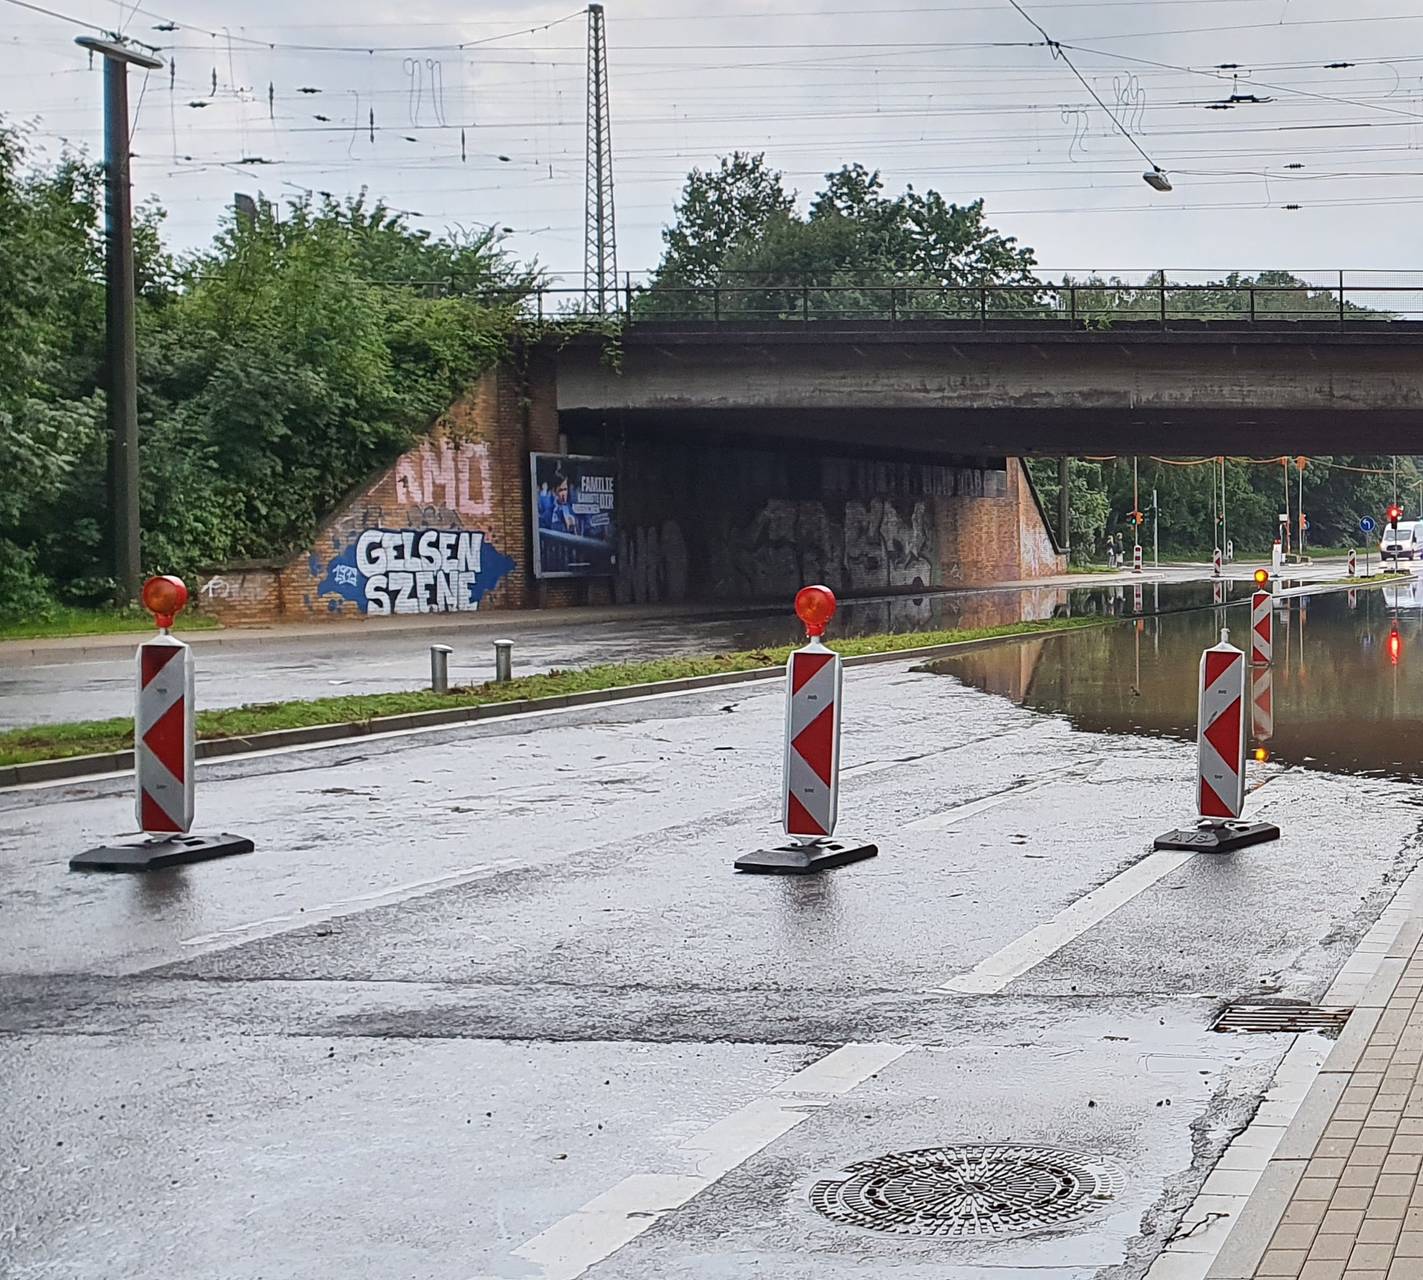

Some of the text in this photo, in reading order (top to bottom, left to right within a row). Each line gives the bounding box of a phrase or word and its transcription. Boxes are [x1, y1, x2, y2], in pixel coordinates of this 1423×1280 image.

[581, 476, 614, 492] FAMILIE
[356, 529, 483, 579] GELSEN
[364, 569, 478, 616] SZENE
